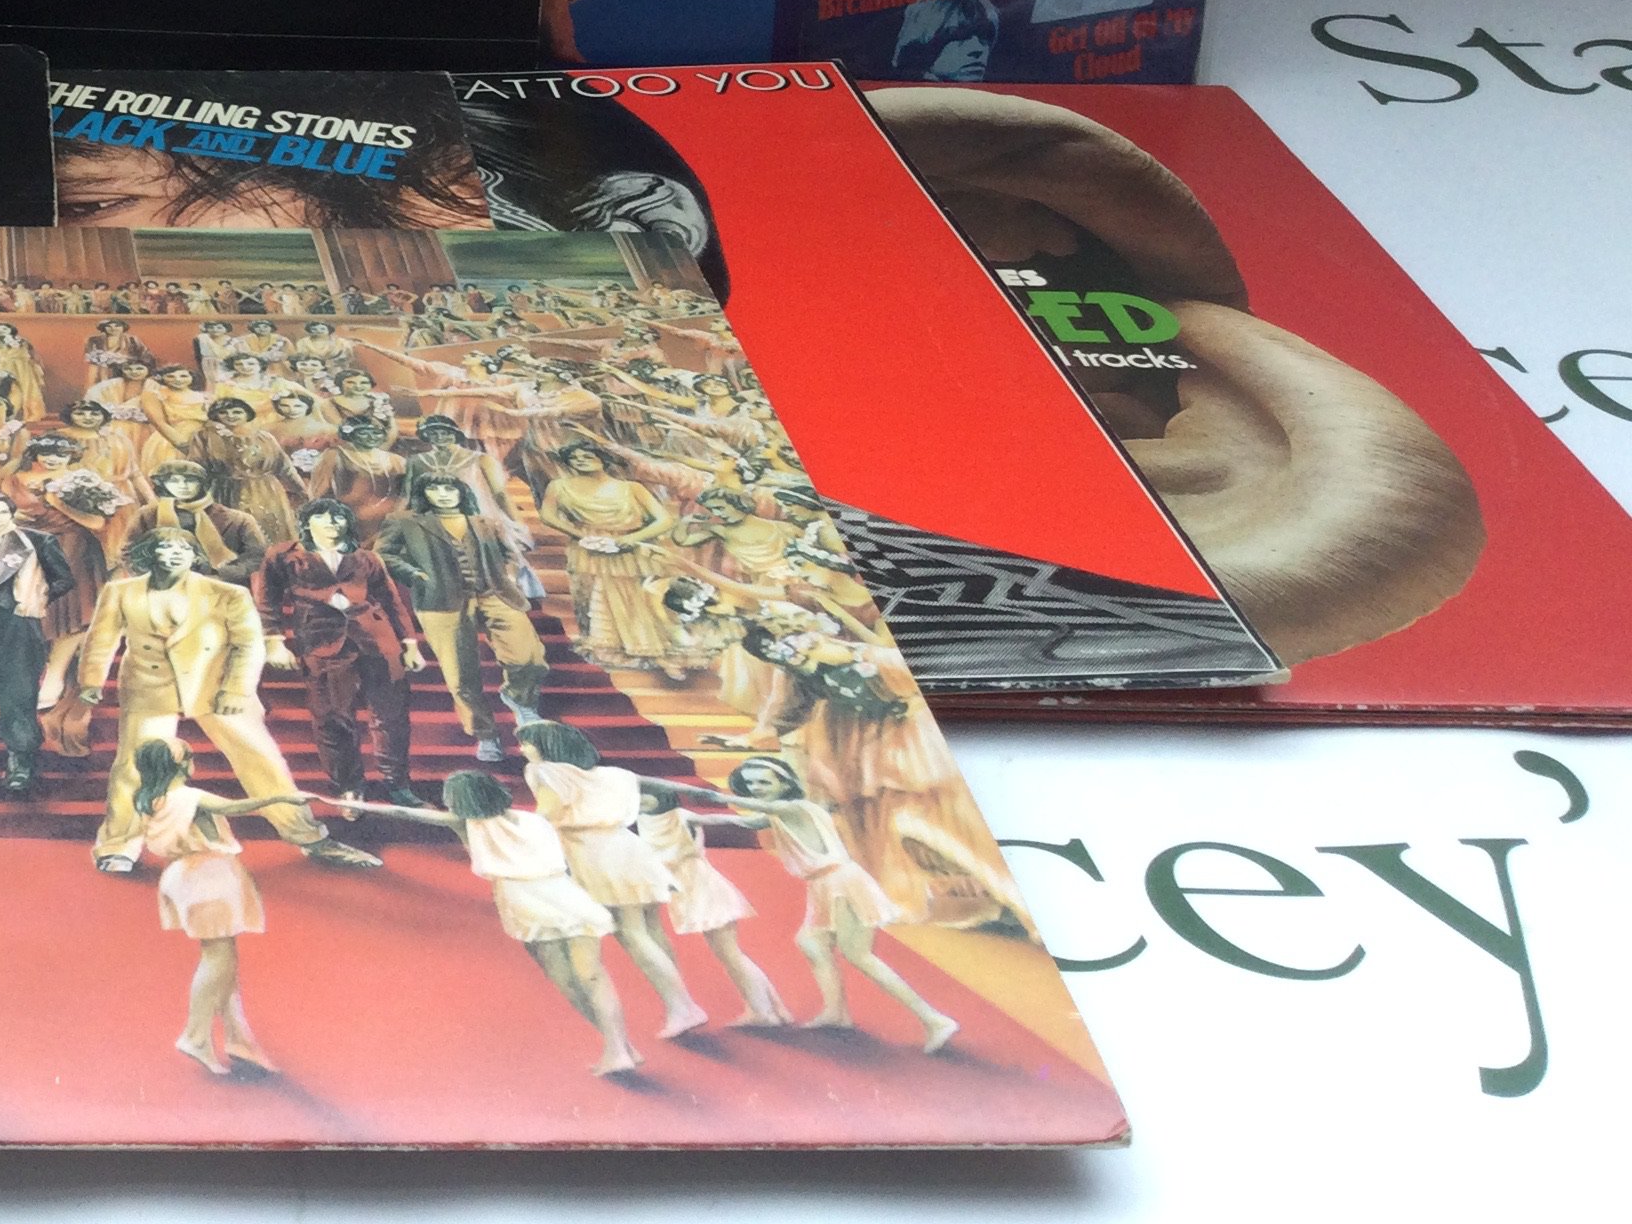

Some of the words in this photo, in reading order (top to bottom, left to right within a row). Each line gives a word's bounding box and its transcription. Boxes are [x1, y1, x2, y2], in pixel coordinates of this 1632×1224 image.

[463, 73, 680, 99] ATTOO
[695, 68, 832, 95] YOU
[103, 89, 258, 129] ROLLING
[264, 110, 417, 149] STONES
[186, 130, 256, 156] AND
[268, 136, 406, 180] BLUE
[994, 268, 1048, 287] ES
[1025, 290, 1181, 344] ED
[1072, 347, 1198, 369] tracks.
